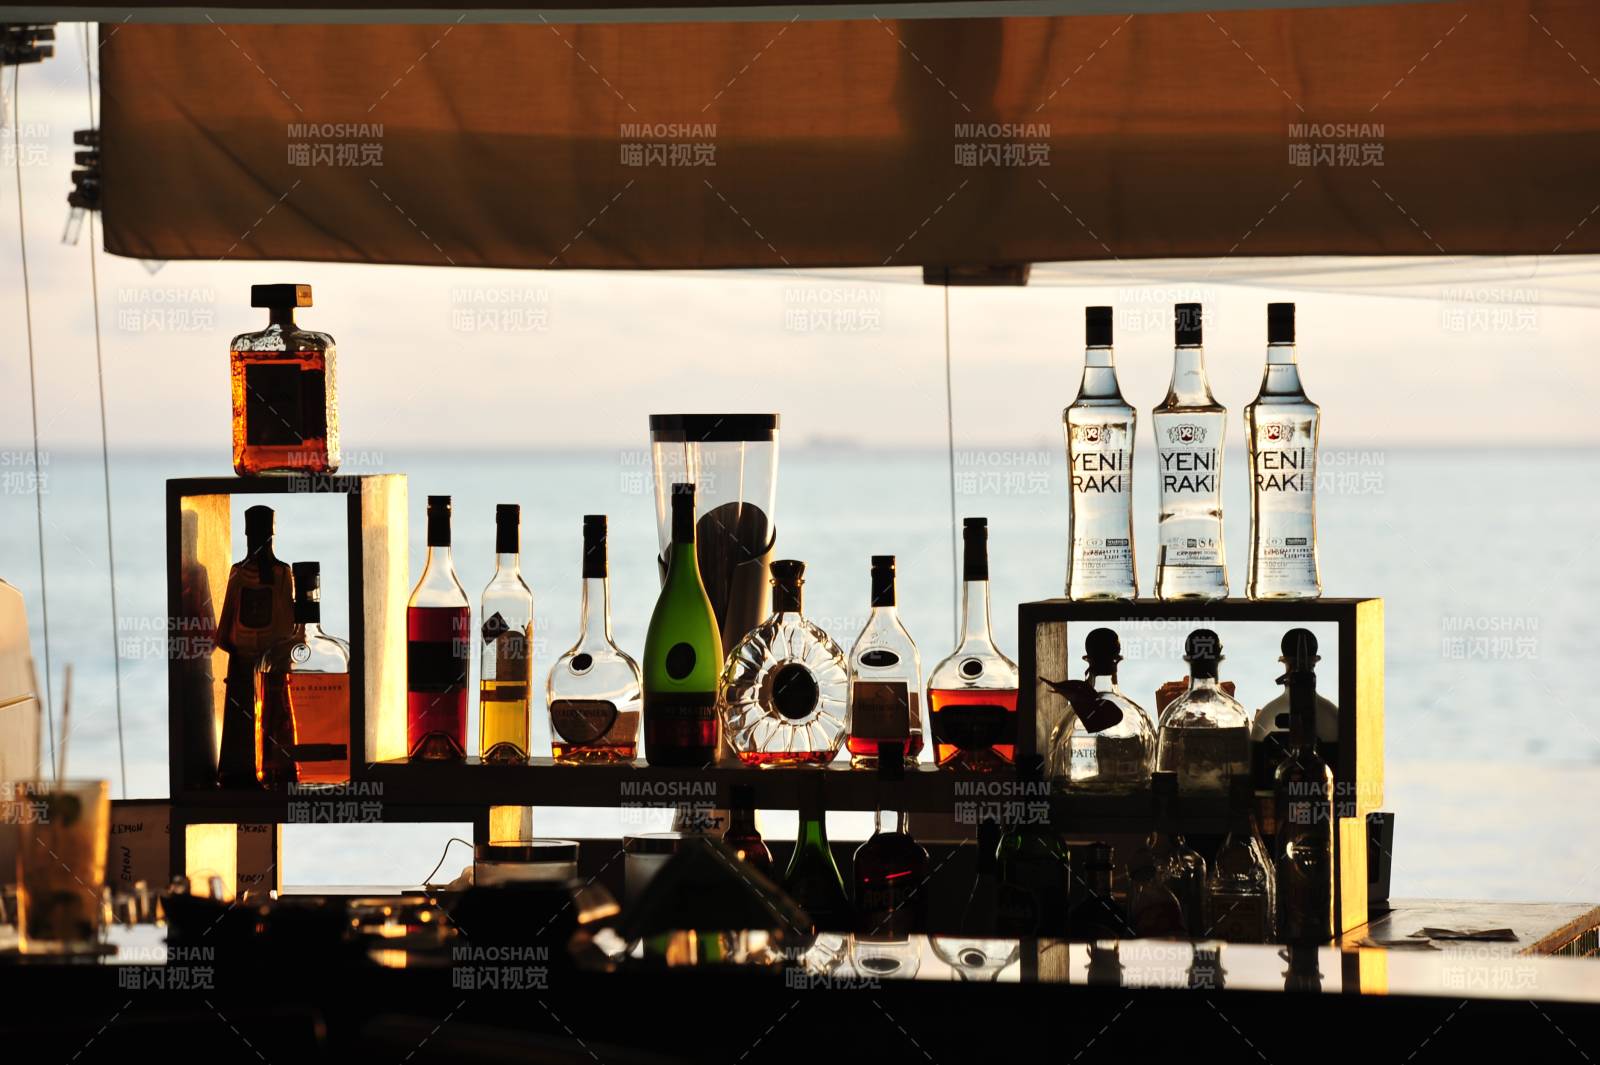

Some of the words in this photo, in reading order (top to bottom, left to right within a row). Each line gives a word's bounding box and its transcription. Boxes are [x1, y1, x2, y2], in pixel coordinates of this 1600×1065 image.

[1165, 475, 1214, 493] RAKI
[111, 822, 143, 834] LEMON
[120, 846, 132, 882] EMON
